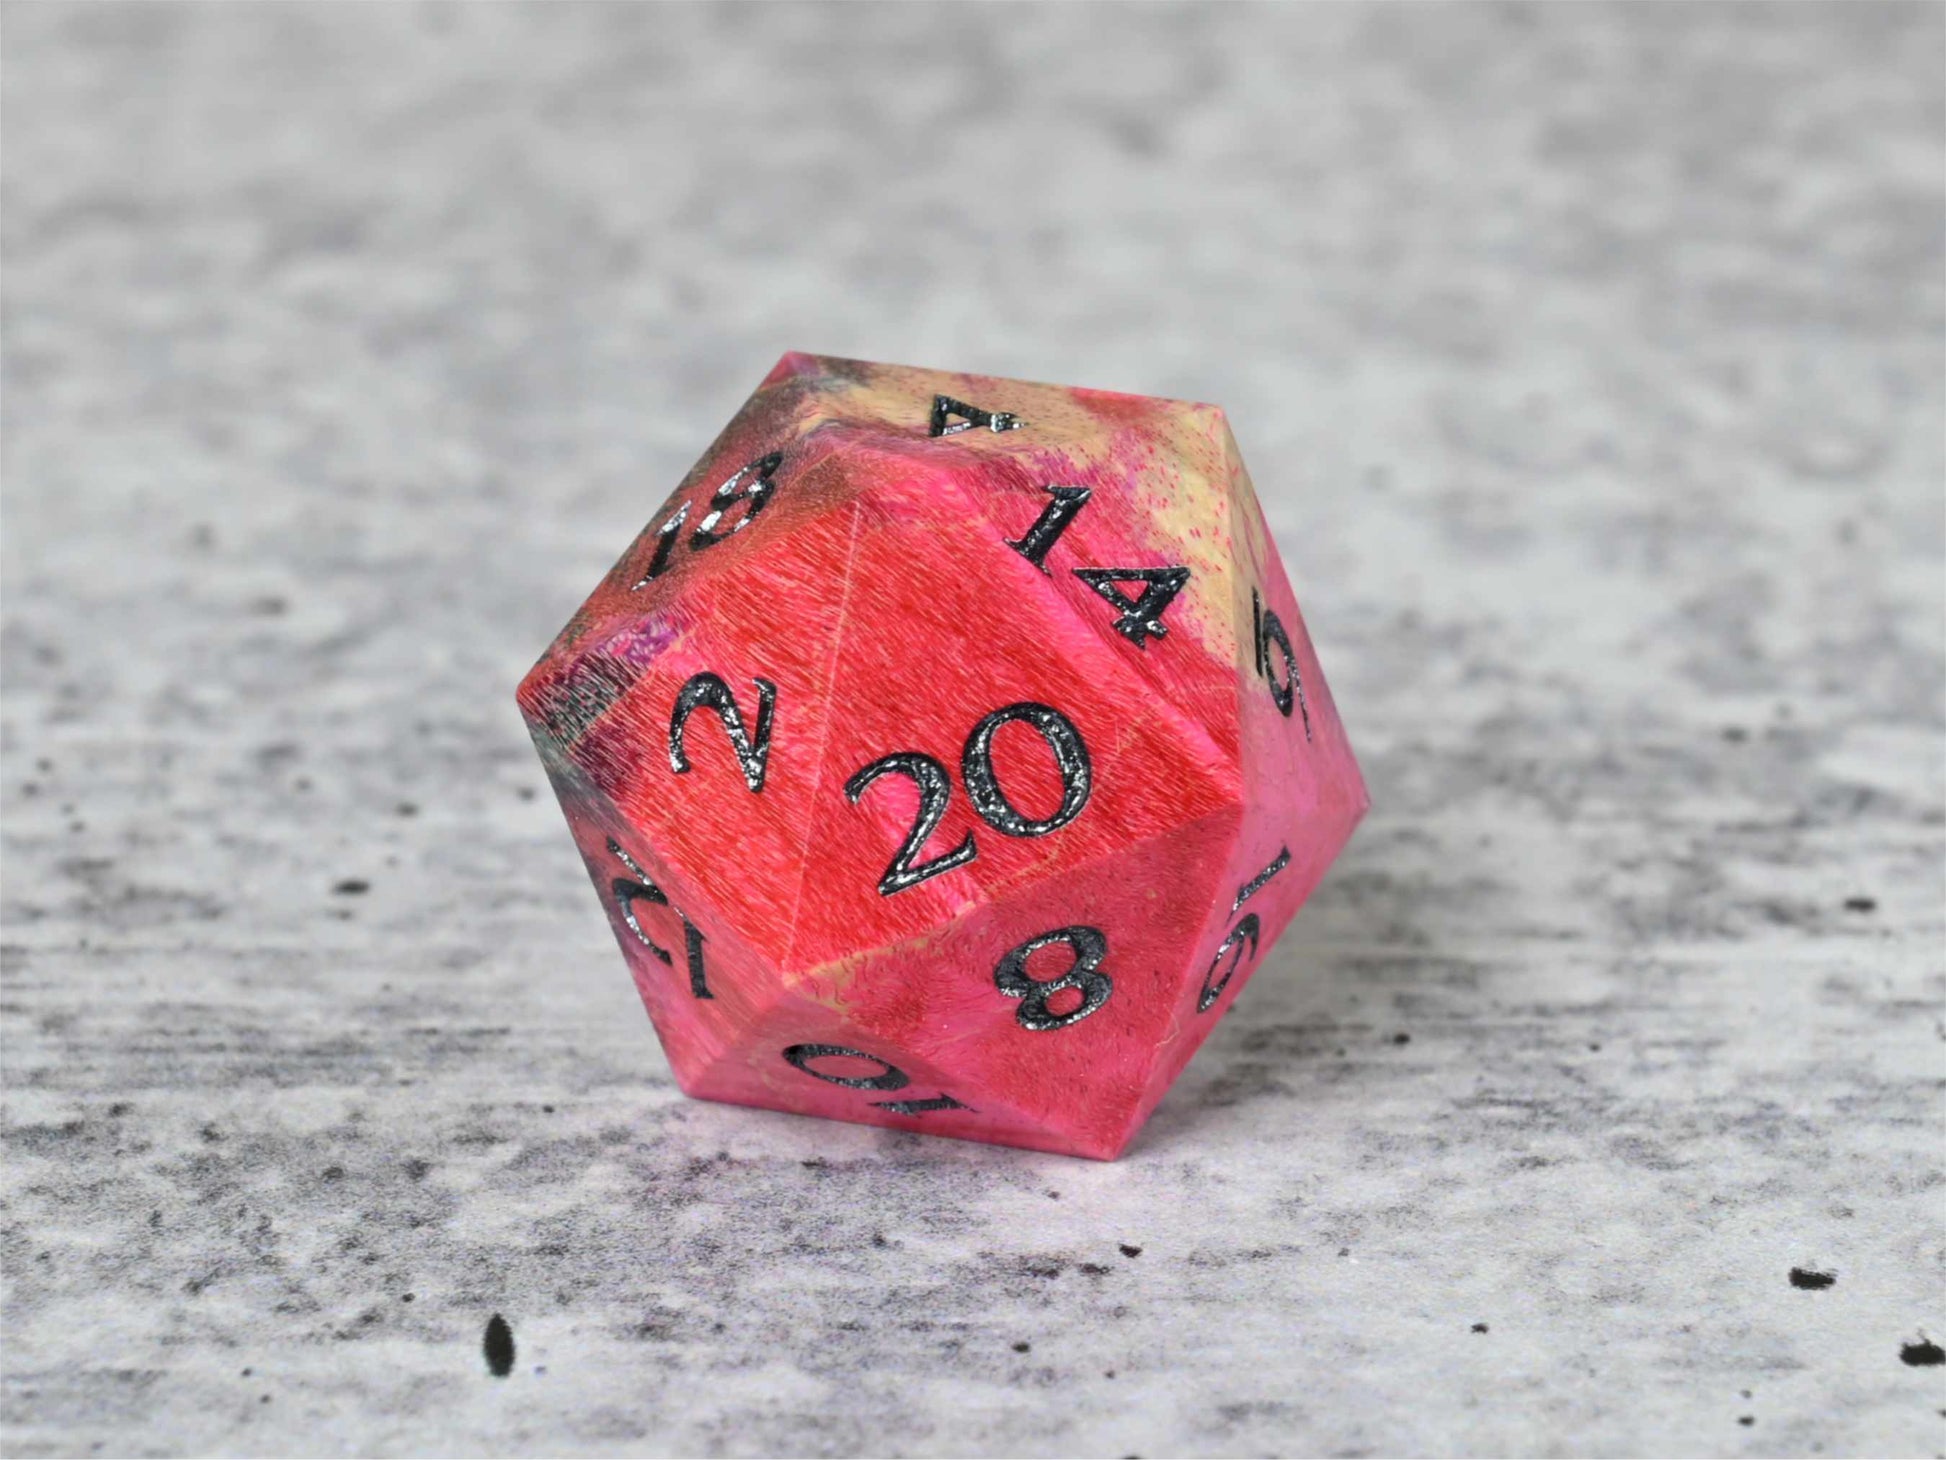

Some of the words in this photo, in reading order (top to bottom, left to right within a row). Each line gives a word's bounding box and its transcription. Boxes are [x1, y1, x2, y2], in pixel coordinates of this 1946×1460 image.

[929, 393, 1029, 438] 4
[631, 450, 784, 591] 18
[1002, 484, 1191, 651] 14
[668, 671, 778, 794] 2
[843, 701, 1092, 897] 20
[606, 835, 715, 999] 12
[993, 925, 1113, 1031] 8
[1197, 844, 1292, 1014] 16
[781, 1043, 981, 1118] 10
